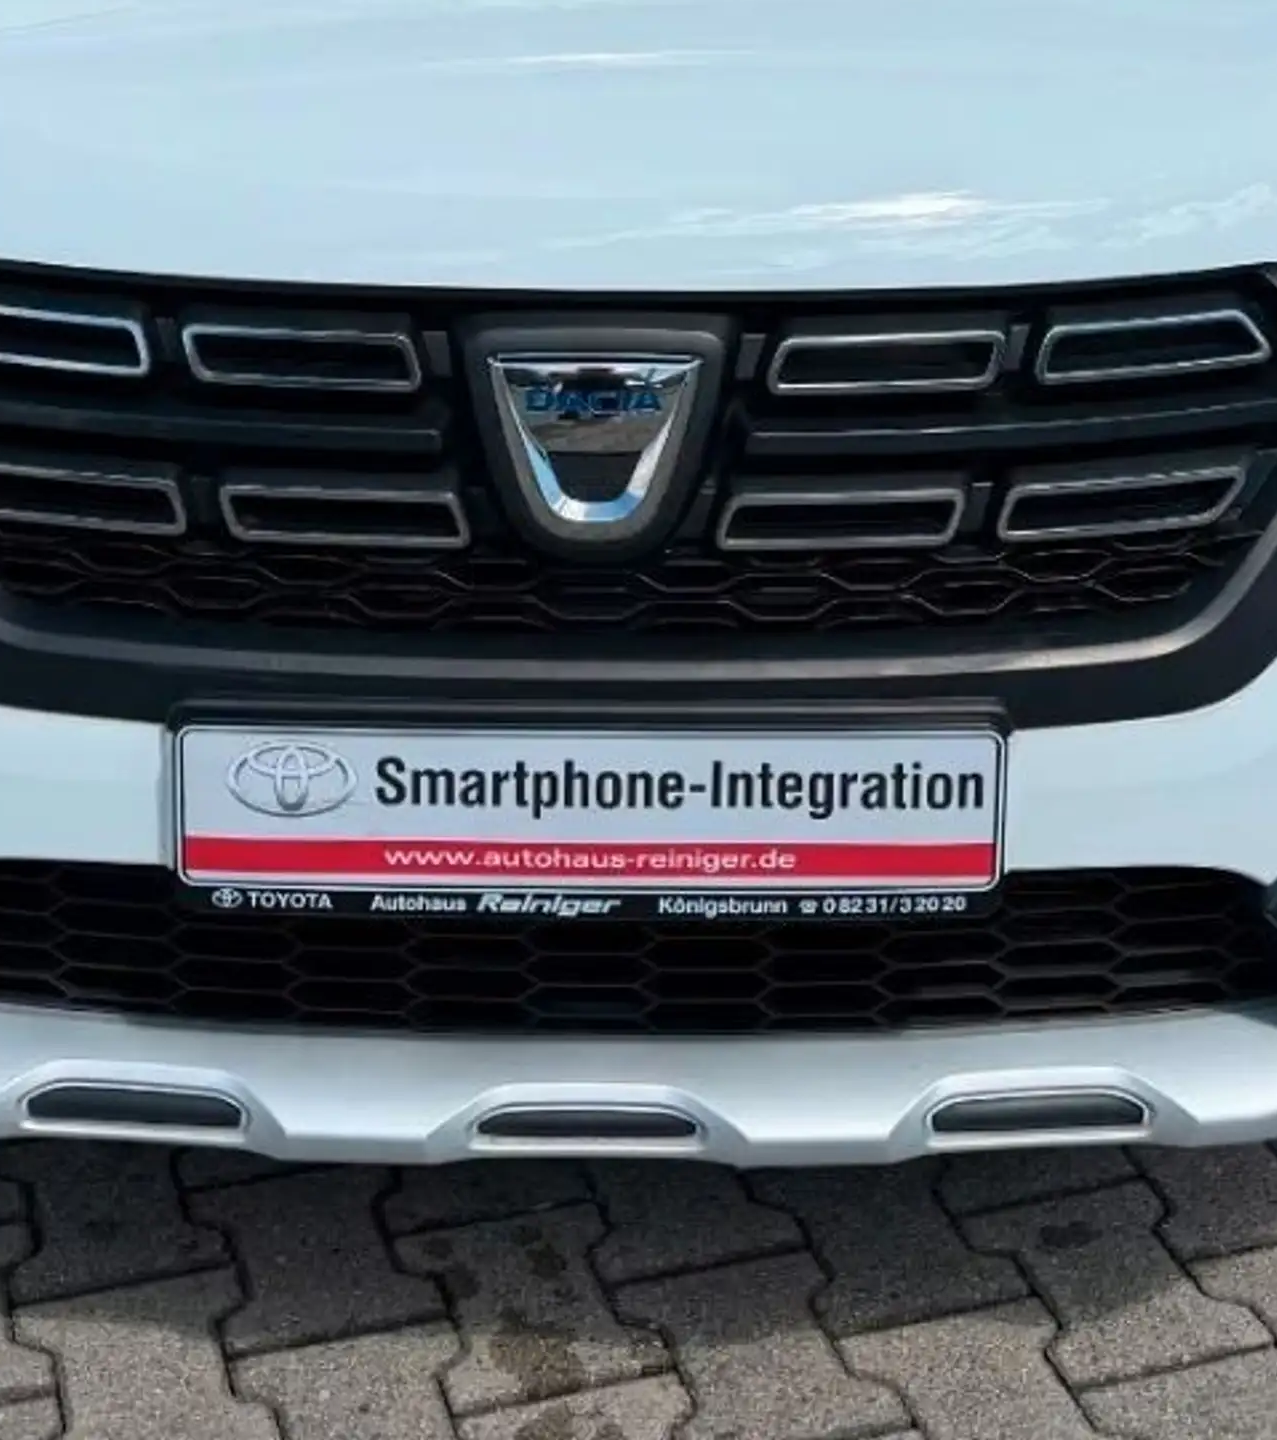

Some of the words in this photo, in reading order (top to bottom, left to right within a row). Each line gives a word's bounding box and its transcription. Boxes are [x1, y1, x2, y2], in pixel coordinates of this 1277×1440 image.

[376, 756, 985, 820] Smartphone-Integration
[384, 847, 797, 873] www.autohaus-reiniger.de
[247, 891, 333, 909] TOYOTA
[370, 894, 467, 911] Autohaus
[659, 896, 788, 918] Königsbrunn
